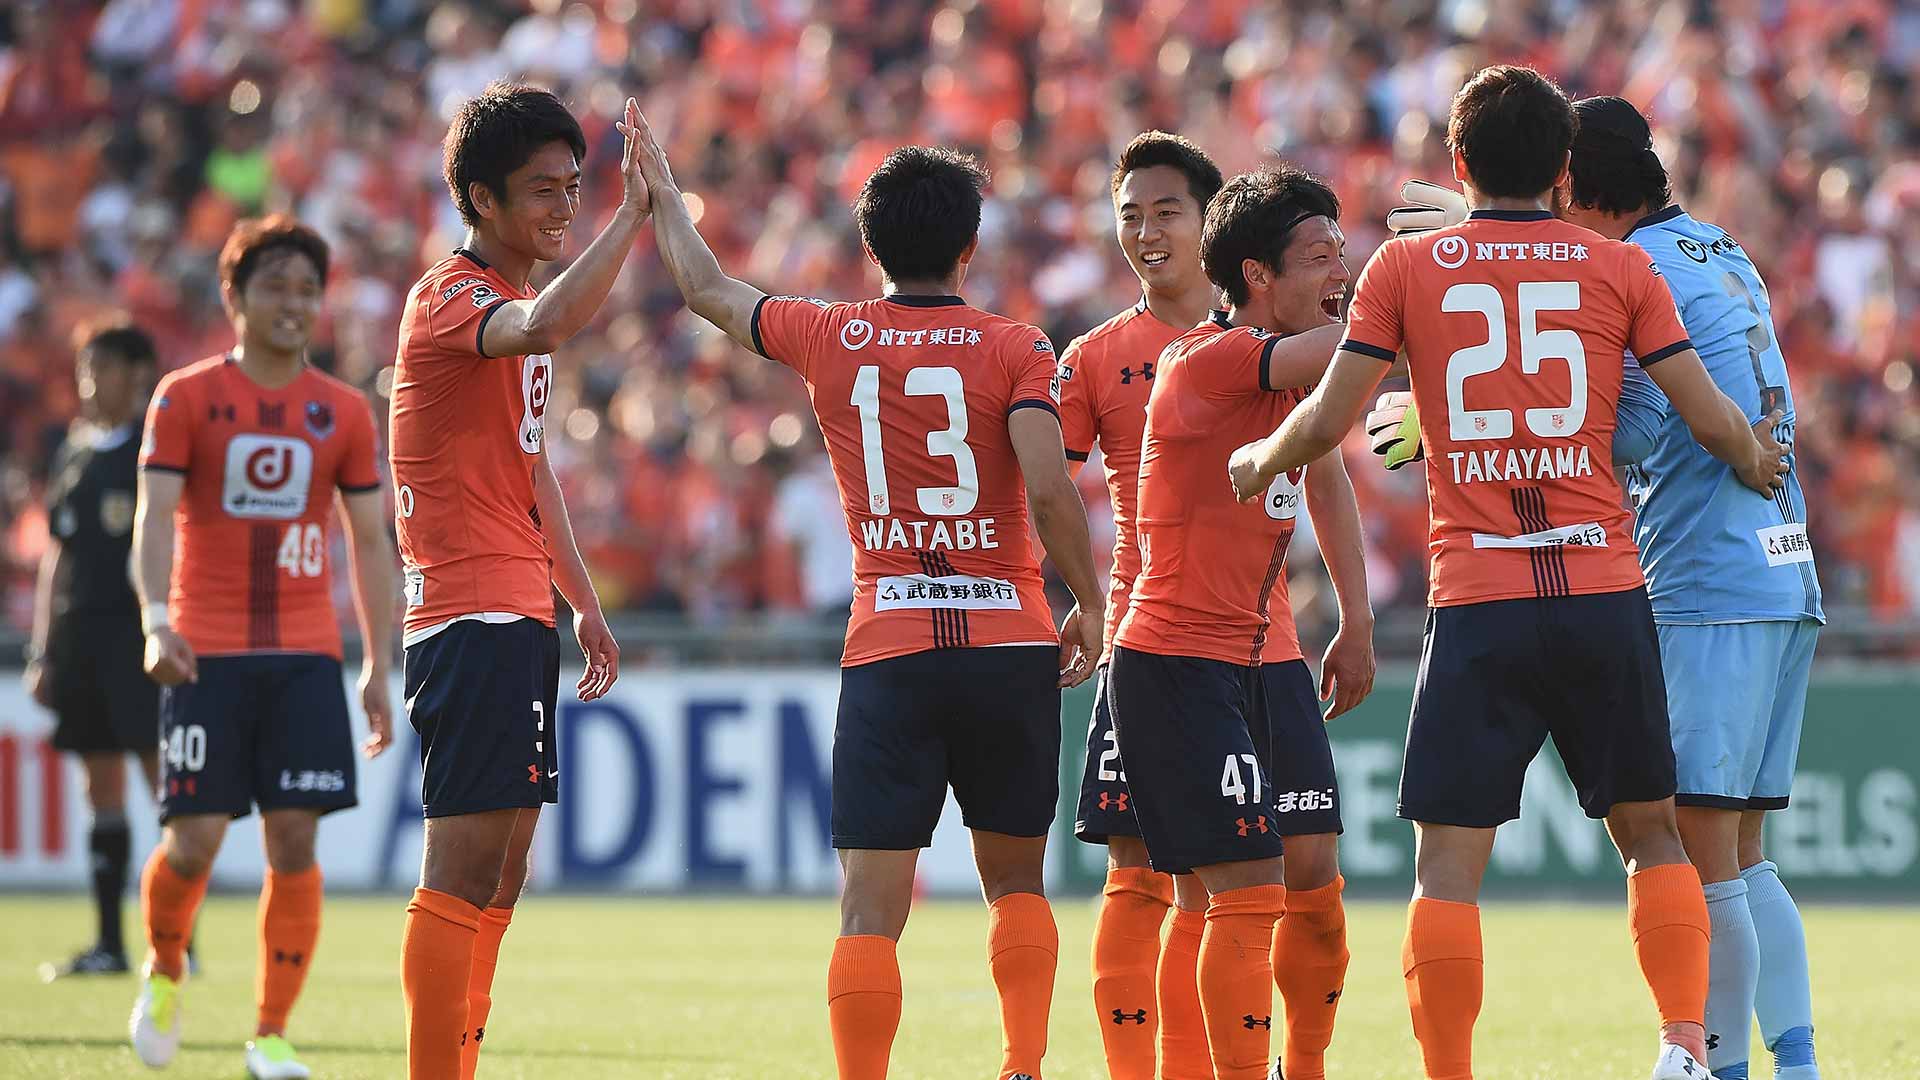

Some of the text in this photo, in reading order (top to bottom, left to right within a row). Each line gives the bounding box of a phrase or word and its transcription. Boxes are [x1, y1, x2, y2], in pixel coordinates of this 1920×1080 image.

[1441, 282, 1588, 441] 25
[850, 366, 979, 516] 13
[1448, 446, 1592, 484] TAKAYAMA
[277, 523, 323, 578] 40
[861, 518, 999, 550] WATABE
[906, 583, 1014, 601] 武蔵野銀行
[168, 725, 207, 771] 40
[1098, 730, 1128, 781] 2
[1221, 754, 1262, 804] 47
[1273, 788, 1333, 813] まむら
